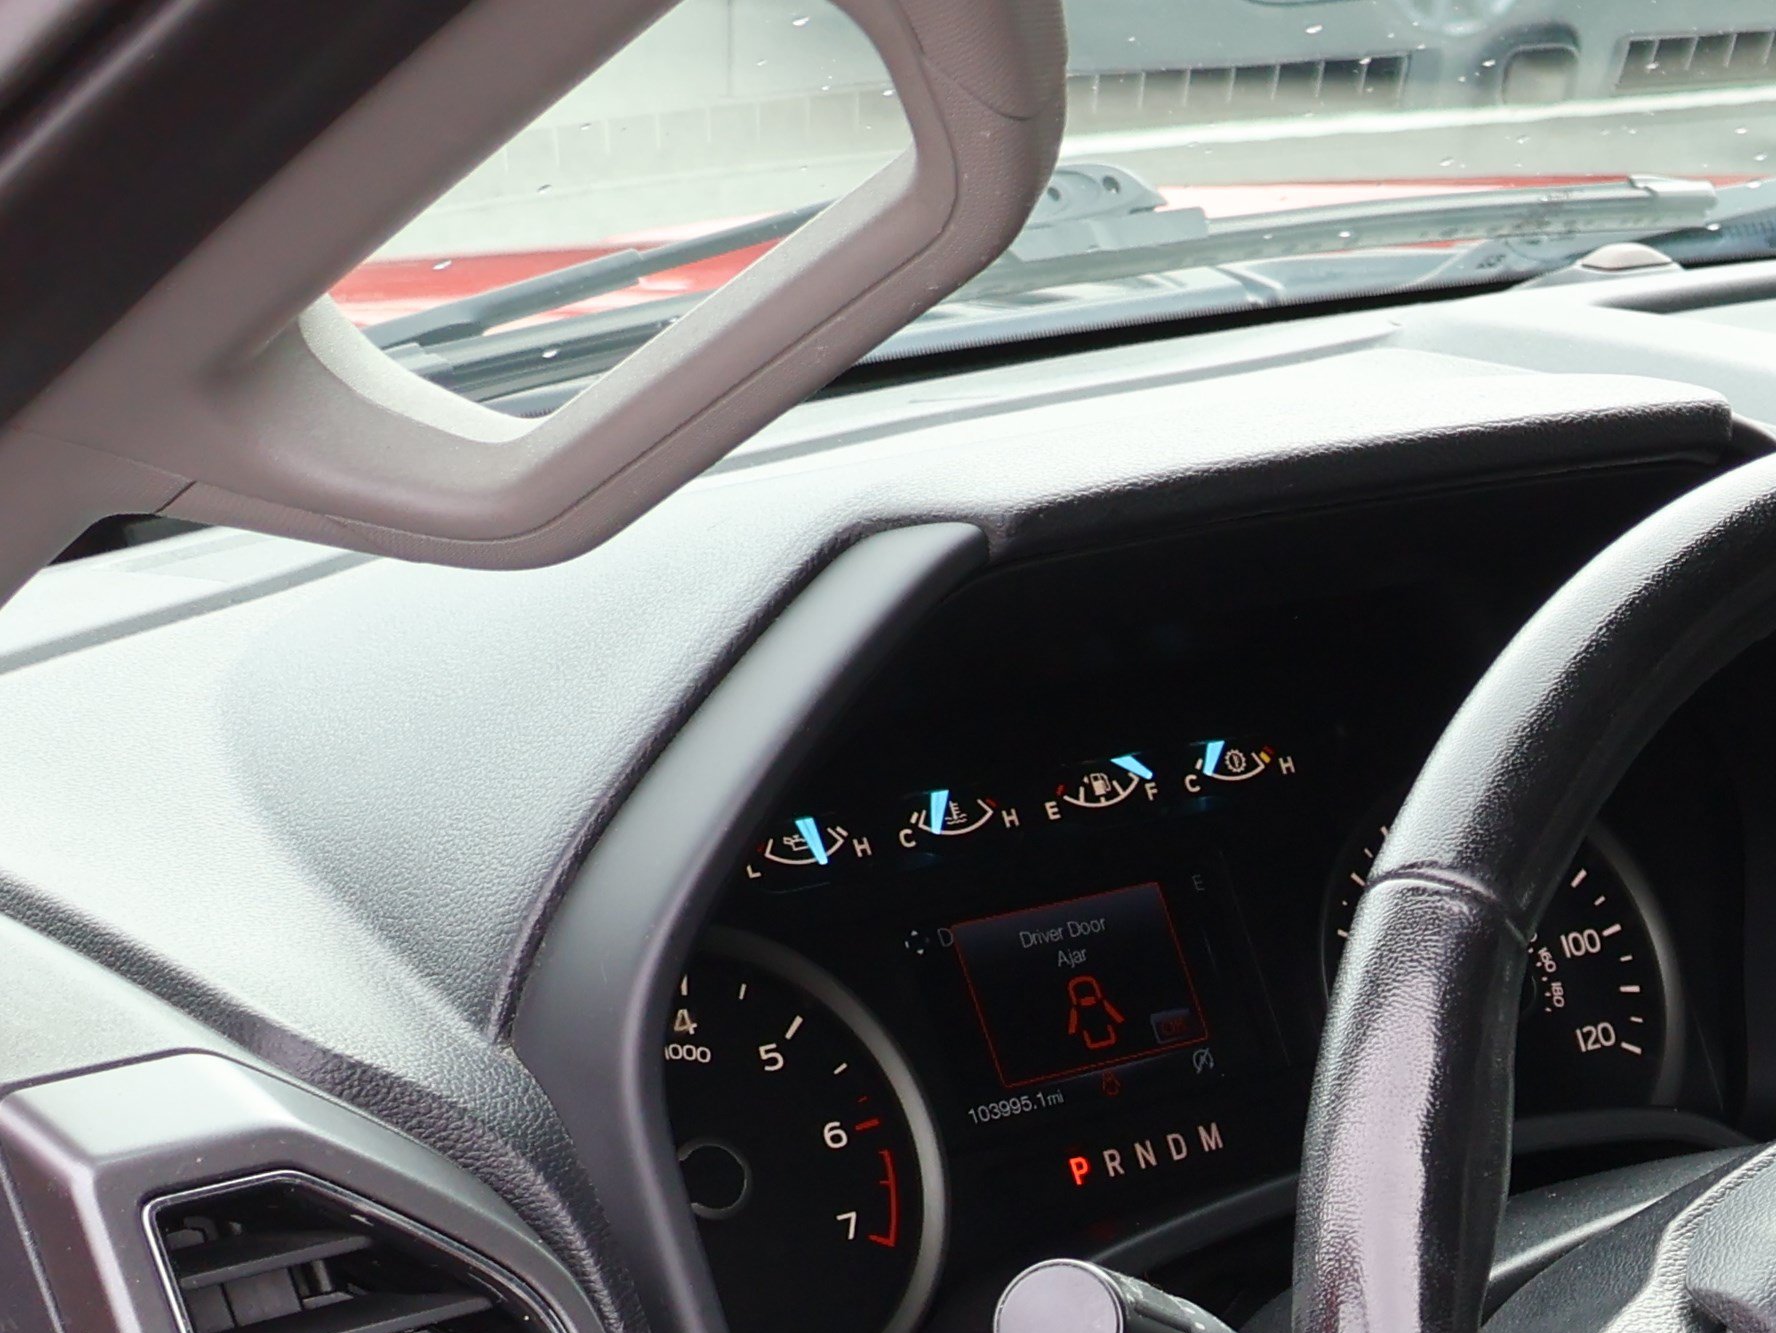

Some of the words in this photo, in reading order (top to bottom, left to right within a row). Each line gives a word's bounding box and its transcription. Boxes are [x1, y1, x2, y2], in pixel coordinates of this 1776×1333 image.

[1184, 774, 1201, 793] C
[1278, 755, 1296, 775] H
[1044, 801, 1061, 820] E
[1145, 782, 1159, 801] F
[899, 828, 917, 848] C
[1001, 808, 1020, 828] H
[852, 836, 872, 858] H
[1019, 925, 1064, 949] Driver
[1068, 917, 1107, 939] Door
[1560, 928, 1601, 959] 100
[1057, 947, 1088, 968] Ajar
[1538, 947, 1557, 973] 160
[1550, 981, 1565, 1008] 180
[673, 1008, 698, 1035] 4
[1575, 1022, 1616, 1053] 120
[758, 1042, 785, 1071] 5
[823, 1121, 848, 1149] 6
[1068, 1156, 1090, 1186] P
[1102, 1148, 1125, 1178] R
[1133, 1139, 1158, 1171] N
[1166, 1132, 1188, 1161] D
[1197, 1121, 1224, 1152] M
[836, 1210, 857, 1240] 7
